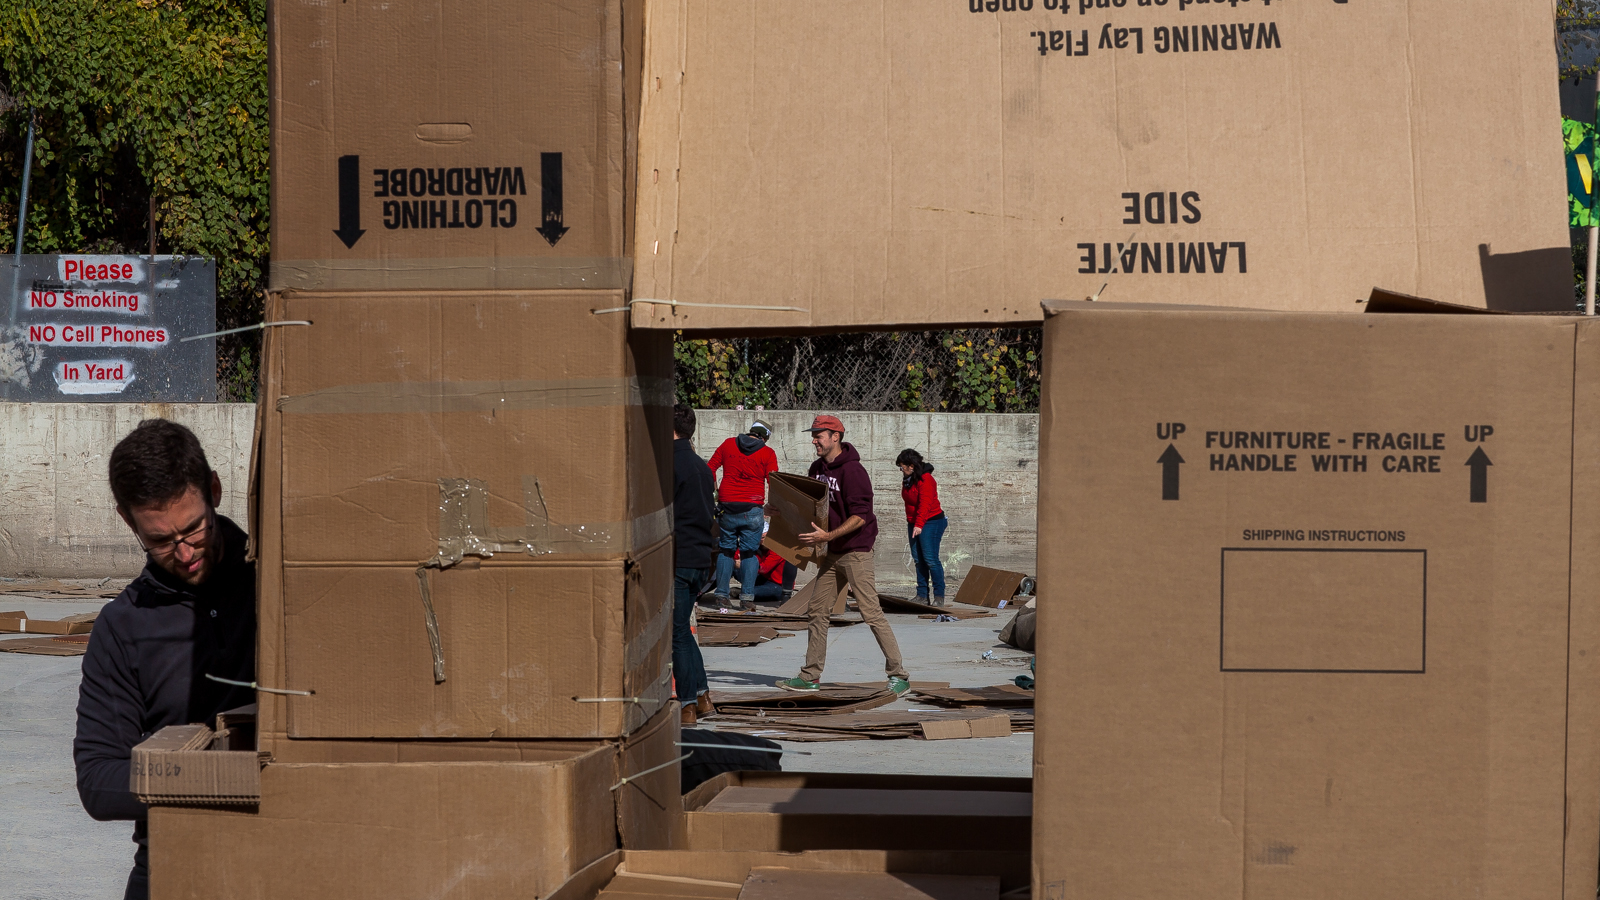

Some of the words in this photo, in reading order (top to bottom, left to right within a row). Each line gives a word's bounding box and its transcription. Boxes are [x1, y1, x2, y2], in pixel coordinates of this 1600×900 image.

[1029, 29, 1089, 57] Flat.
[1098, 22, 1144, 54] Lay
[1153, 21, 1282, 54] WARNING
[373, 166, 527, 198] WARDROBE
[382, 198, 518, 230] CLOTHING
[1121, 190, 1202, 225] SIDE
[1076, 241, 1248, 275] LAMINATE
[64, 259, 133, 281] Please
[31, 291, 57, 308] NO
[63, 291, 139, 312] Smoking
[30, 325, 56, 343] NO
[62, 325, 95, 343] Cell
[101, 325, 166, 343] Phones
[64, 363, 79, 381] In
[85, 363, 124, 381] Yard
[1156, 422, 1187, 441] UP
[1205, 430, 1331, 450] FURNITURE
[1352, 431, 1446, 451] FRAGILE
[1464, 424, 1494, 443] UP
[1209, 453, 1297, 473] HANDLE
[1310, 454, 1368, 474] WITH
[1381, 454, 1441, 474] CARE
[1242, 528, 1305, 542] SHIPPING
[1308, 529, 1406, 543] INSTRUCTIONS
